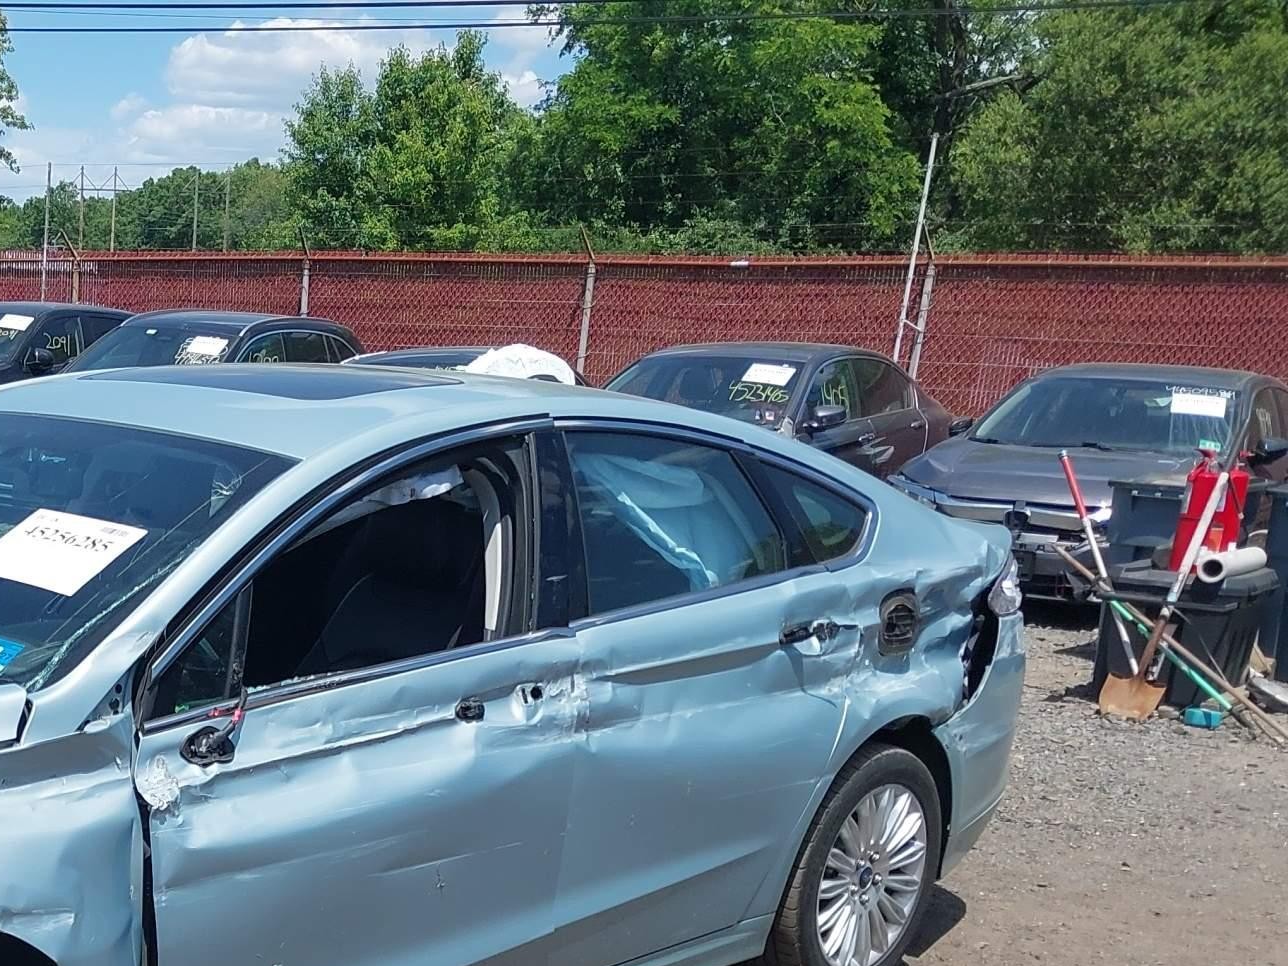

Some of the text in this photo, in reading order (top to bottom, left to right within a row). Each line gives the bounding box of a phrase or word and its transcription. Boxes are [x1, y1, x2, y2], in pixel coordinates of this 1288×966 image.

[43, 332, 71, 357] 2091
[728, 380, 790, 403] 45231405
[24, 525, 115, 553] 45256285
